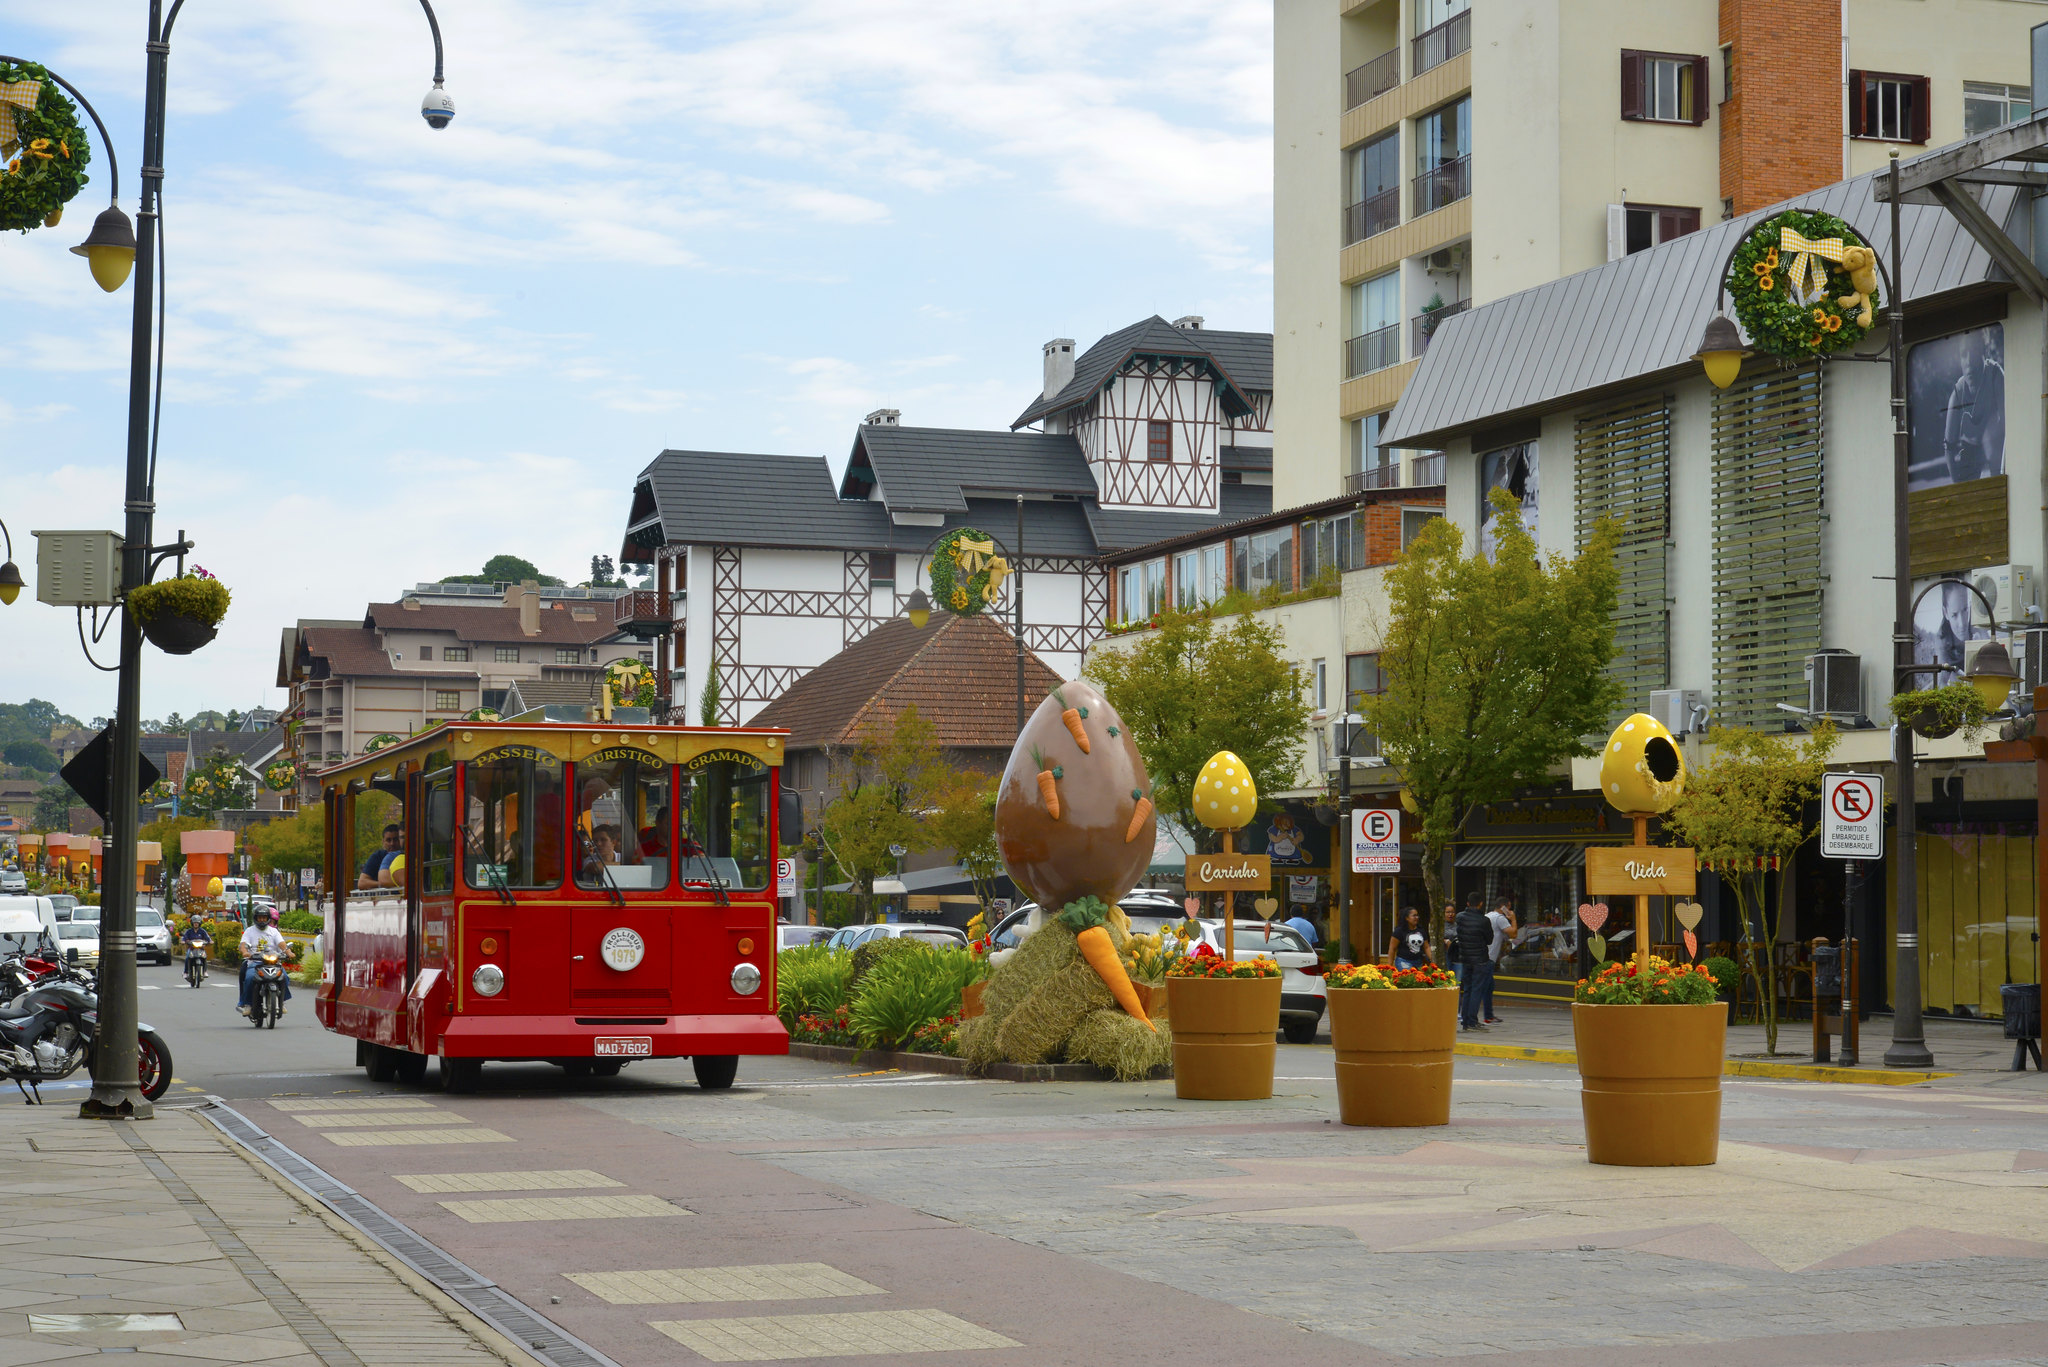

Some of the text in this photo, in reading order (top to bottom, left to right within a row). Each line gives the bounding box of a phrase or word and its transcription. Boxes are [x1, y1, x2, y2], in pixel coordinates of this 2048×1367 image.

[475, 748, 763, 771] PASSEIO TURISTICO GRAMADO
[1844, 789, 1860, 811] E
[1371, 817, 1384, 836] E
[1829, 841, 1873, 849] DESEMBARQUE
[778, 862, 787, 875] E
[1200, 861, 1259, 883] Carinho
[1624, 860, 1667, 881] Vida
[605, 931, 642, 951] TROLLIBUS
[612, 949, 636, 964] 1979
